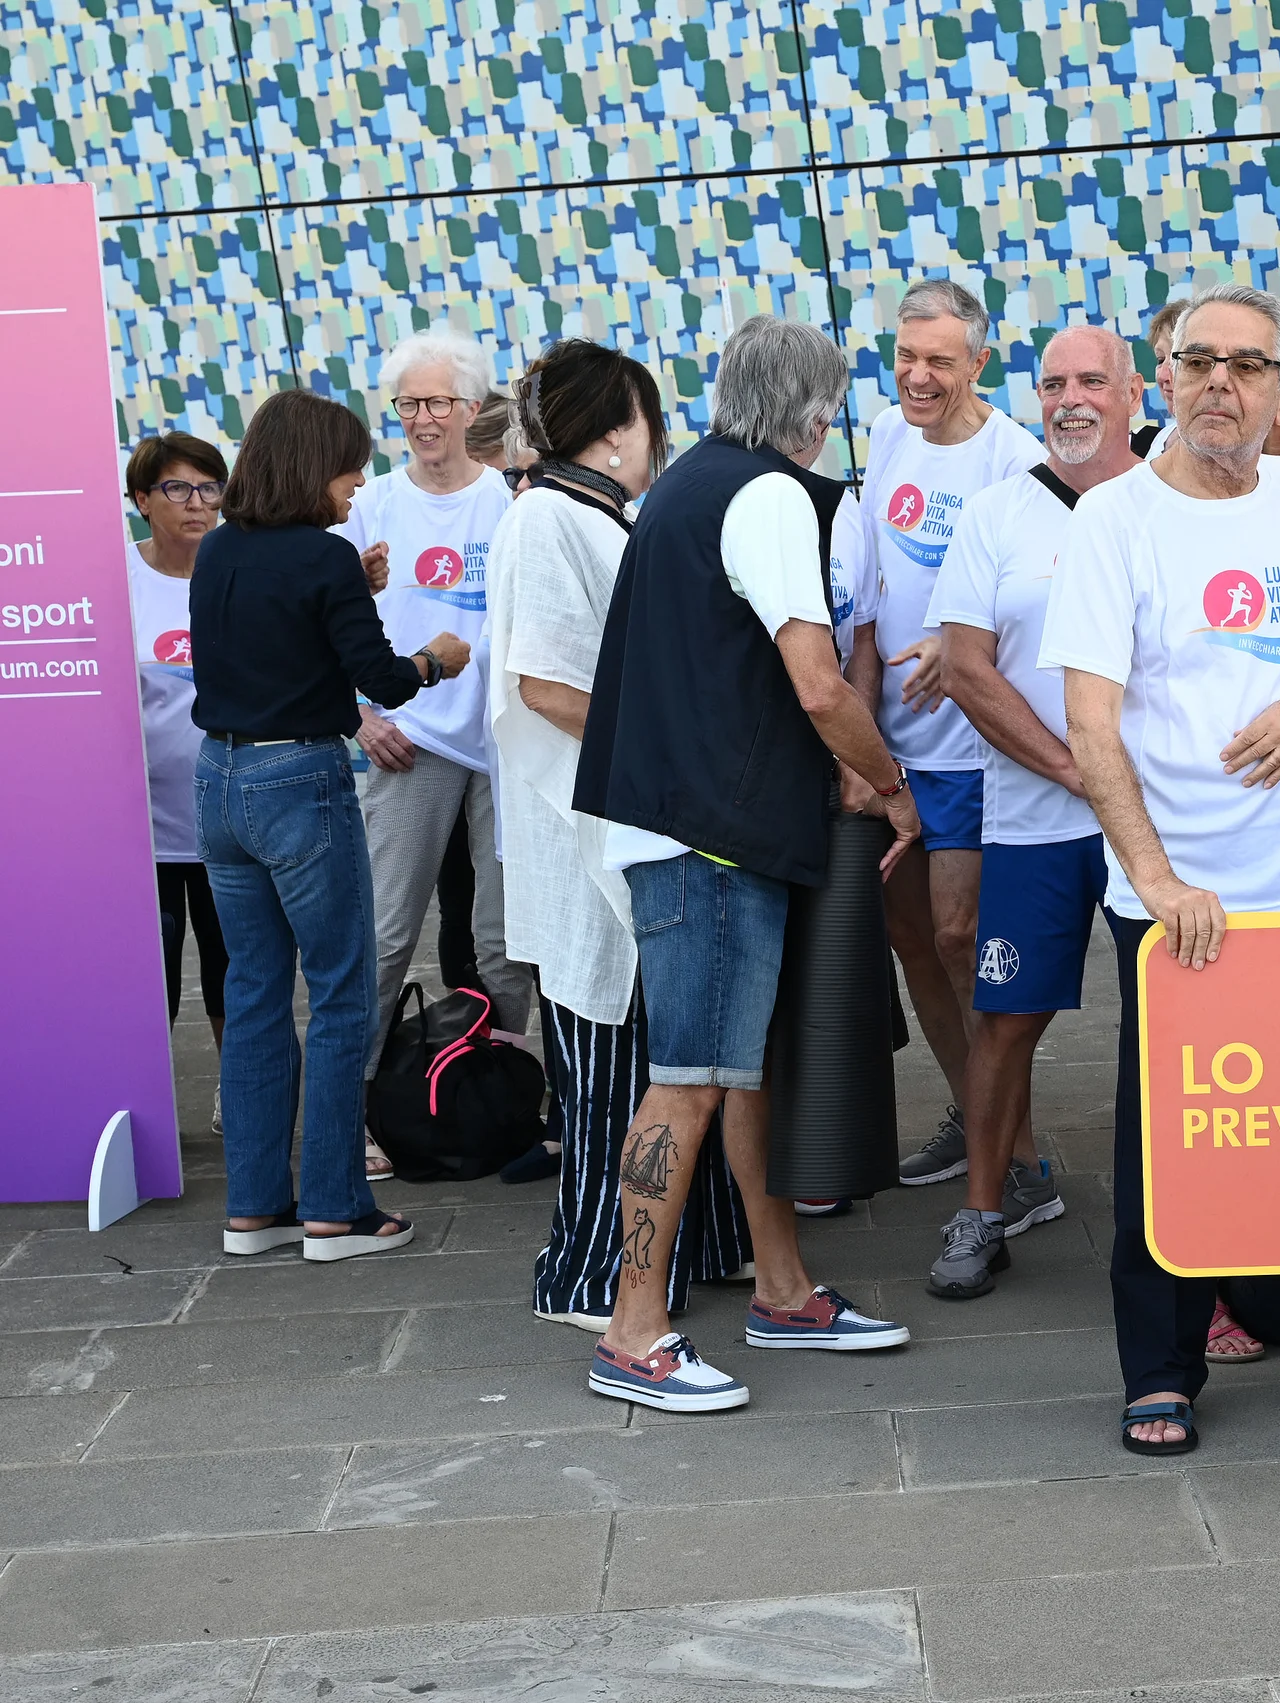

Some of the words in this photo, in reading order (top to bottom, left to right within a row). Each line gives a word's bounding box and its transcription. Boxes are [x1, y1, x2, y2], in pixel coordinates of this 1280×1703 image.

[929, 490, 963, 510] LUNGA
[926, 505, 946, 521] VITA
[920, 520, 953, 538] ATTIVA
[463, 542, 489, 555] LUNG
[924, 552, 937, 560] CON
[463, 556, 486, 568] VITA
[464, 570, 487, 582] ATTI
[1, 597, 94, 634] sport
[0, 659, 99, 680] um.com
[1181, 1042, 1264, 1095] LO
